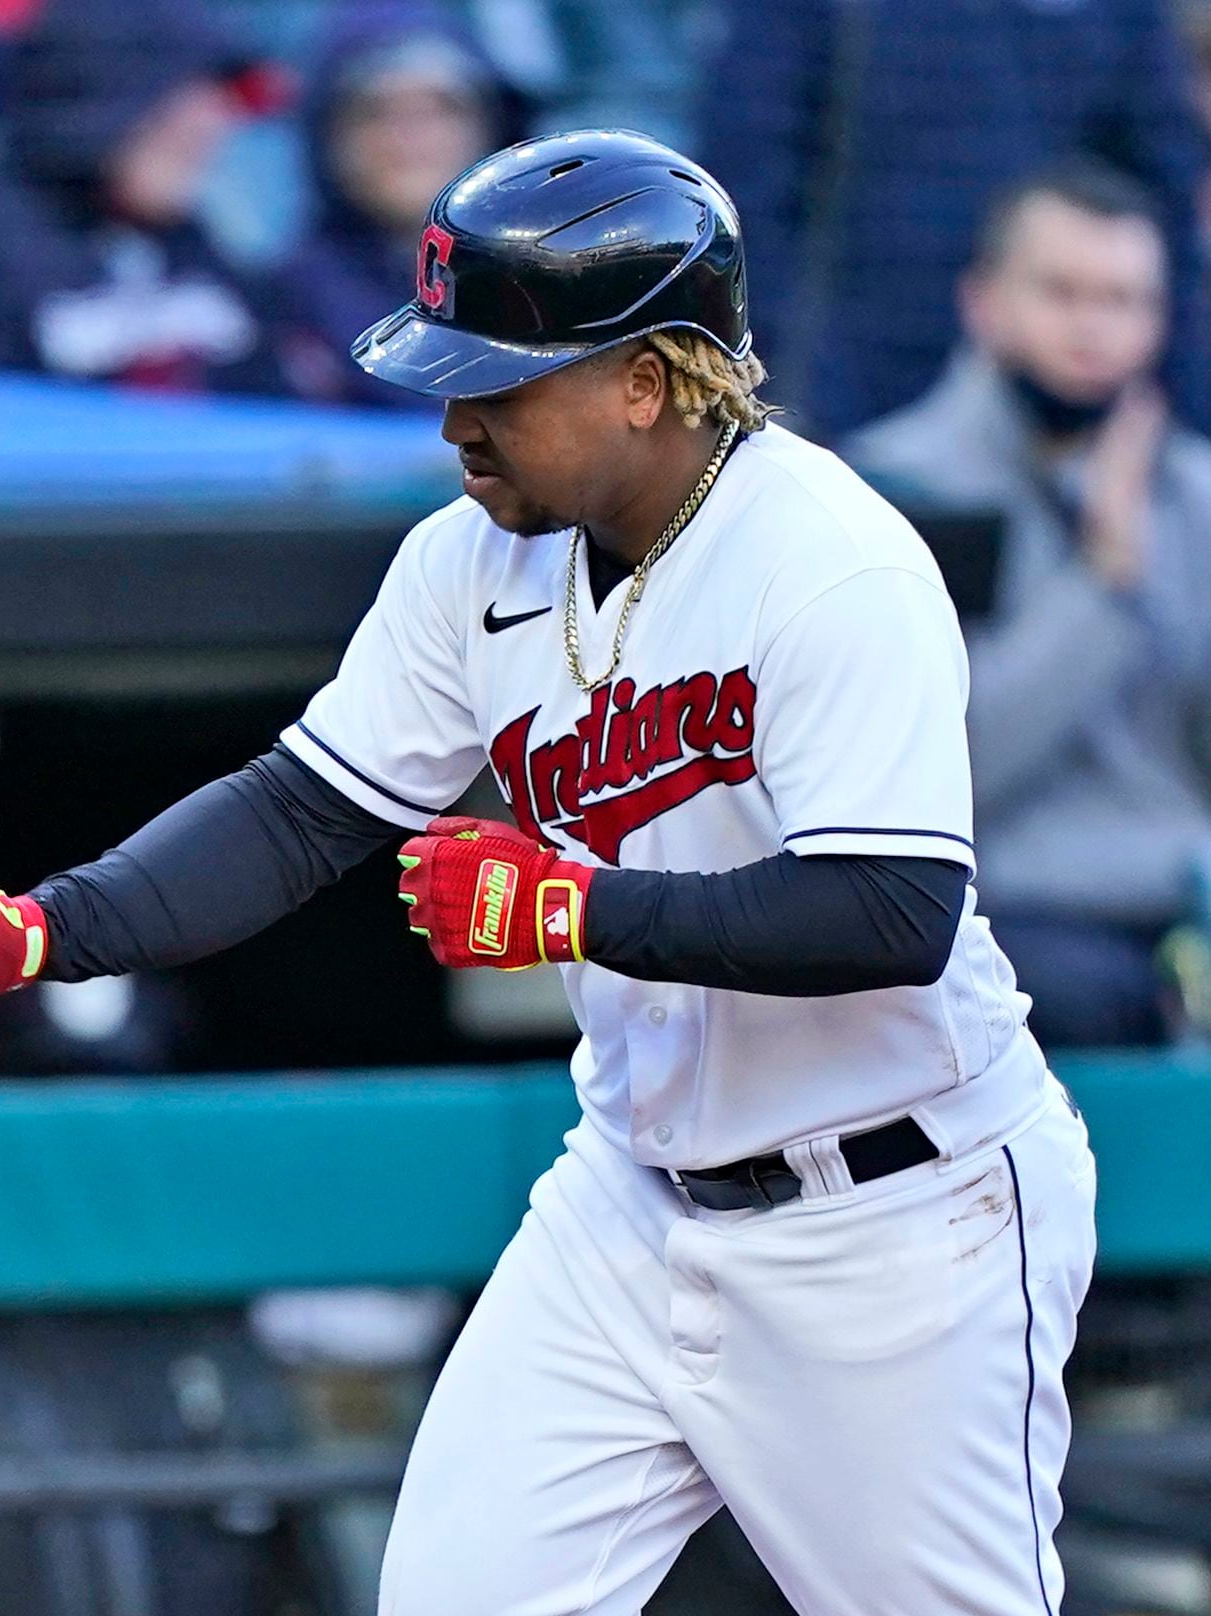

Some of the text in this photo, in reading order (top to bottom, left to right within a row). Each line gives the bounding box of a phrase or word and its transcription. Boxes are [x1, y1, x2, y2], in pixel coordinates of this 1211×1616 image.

[416, 223, 453, 309] C
[489, 664, 757, 851] Indians
[474, 863, 509, 951] Franklin
